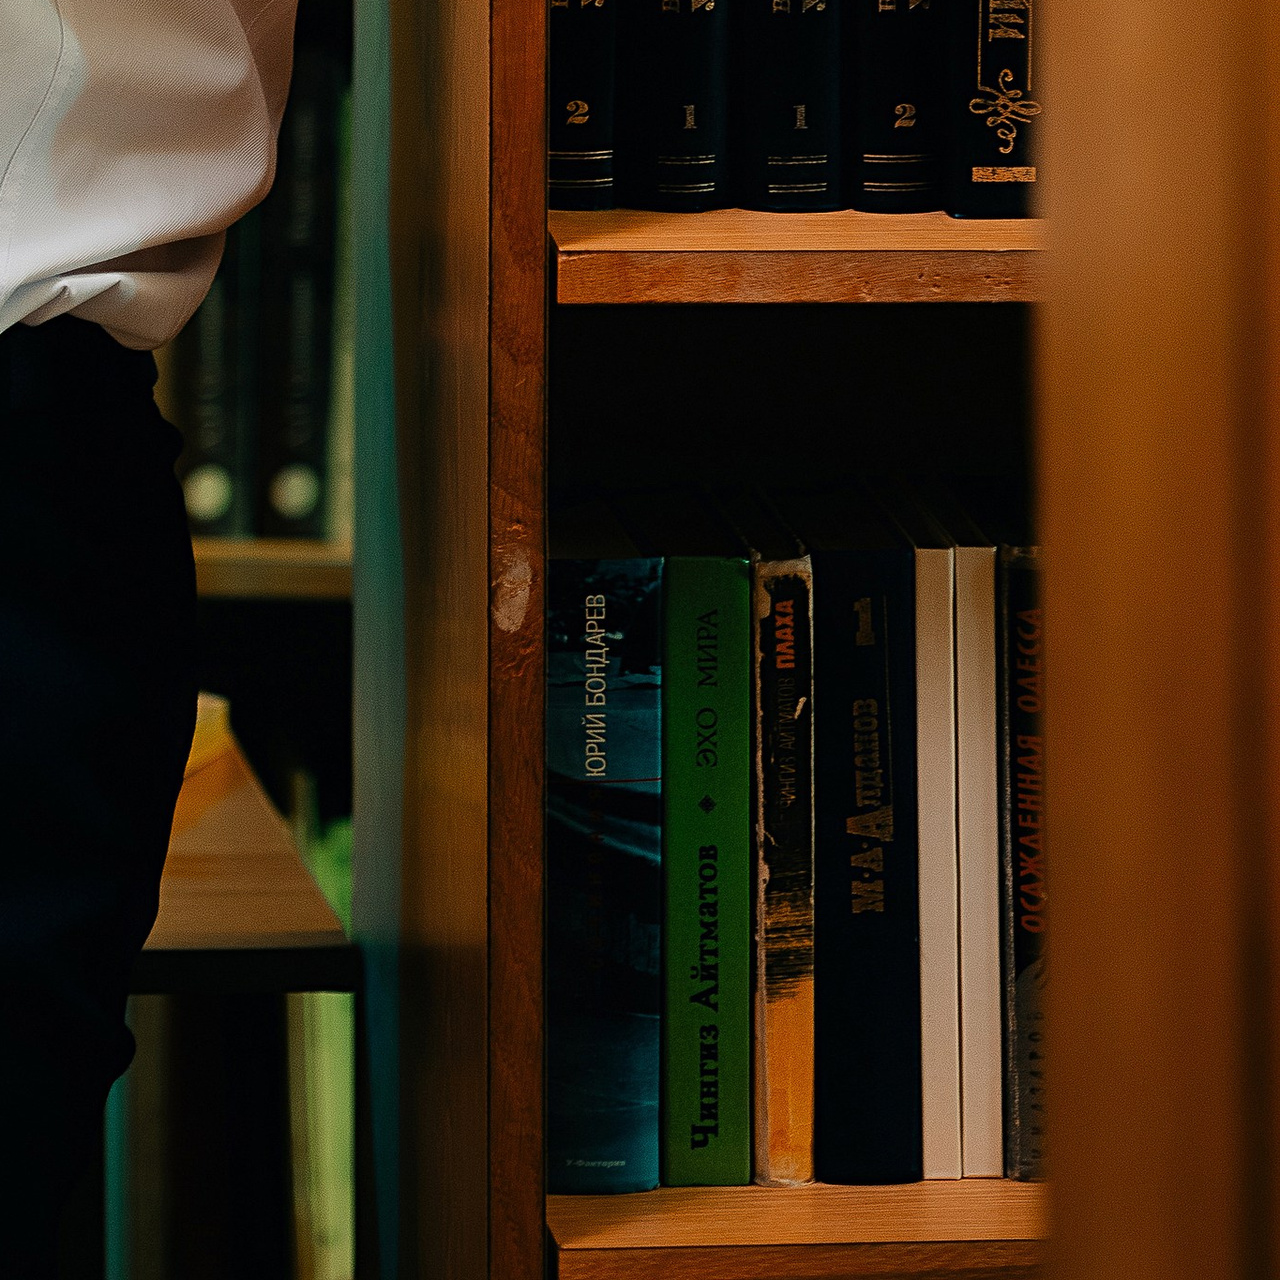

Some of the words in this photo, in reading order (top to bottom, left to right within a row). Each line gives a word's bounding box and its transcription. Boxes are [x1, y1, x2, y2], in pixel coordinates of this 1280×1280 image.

[565, 100, 590, 126] 2
[893, 103, 917, 129] 2
[585, 593, 610, 706] БОНДАРЕВ
[696, 608, 718, 687] МИРА
[775, 599, 795, 669] ПЛАХА
[581, 713, 607, 777] ЮРИЙ
[696, 707, 718, 768] ЭХО
[775, 677, 795, 750] АЙТМАТОВ
[777, 756, 796, 808] ЧИНГИЗ
[689, 845, 719, 1013] Айтматов
[690, 1024, 719, 1150] Чингиз
